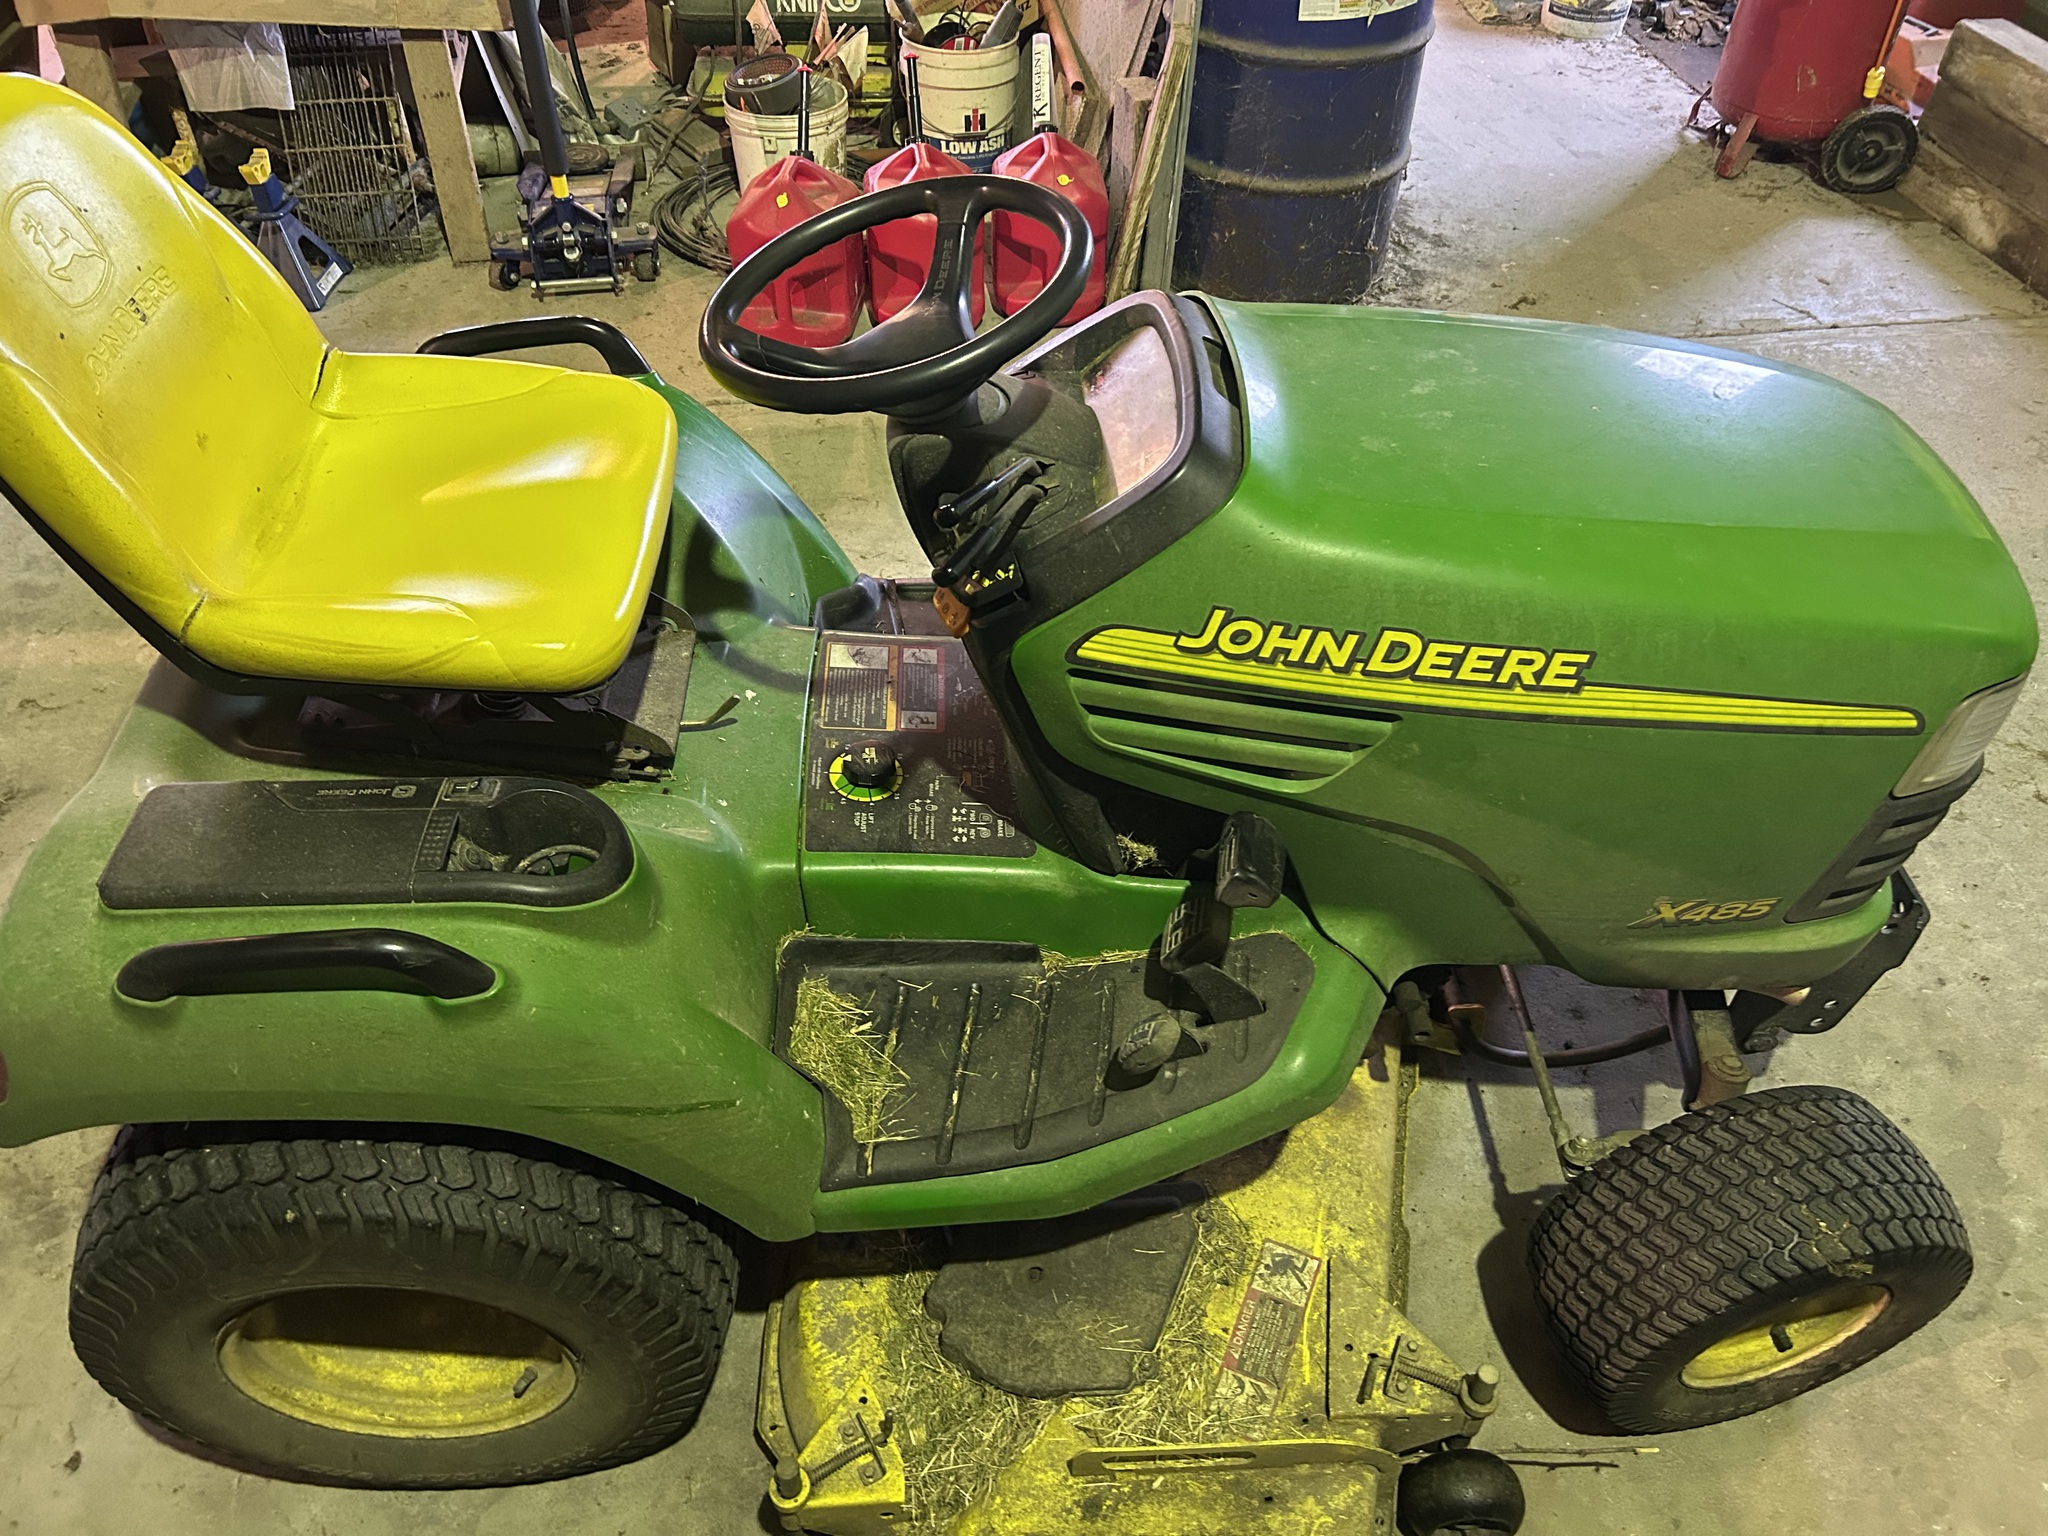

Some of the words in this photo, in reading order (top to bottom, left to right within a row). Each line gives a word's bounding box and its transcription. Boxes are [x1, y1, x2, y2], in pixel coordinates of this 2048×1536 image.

[1034, 51, 1042, 102] REGENT
[940, 139, 978, 155] LOW
[979, 134, 1005, 153] ASH
[933, 239, 954, 290] DEERE
[1176, 606, 1364, 674] JOHN
[1364, 627, 1595, 692] DEERE
[316, 788, 357, 796] DEERE
[358, 788, 391, 796] JOHN
[1627, 897, 1783, 928] X485
[1232, 1299, 1256, 1346] DANGER
